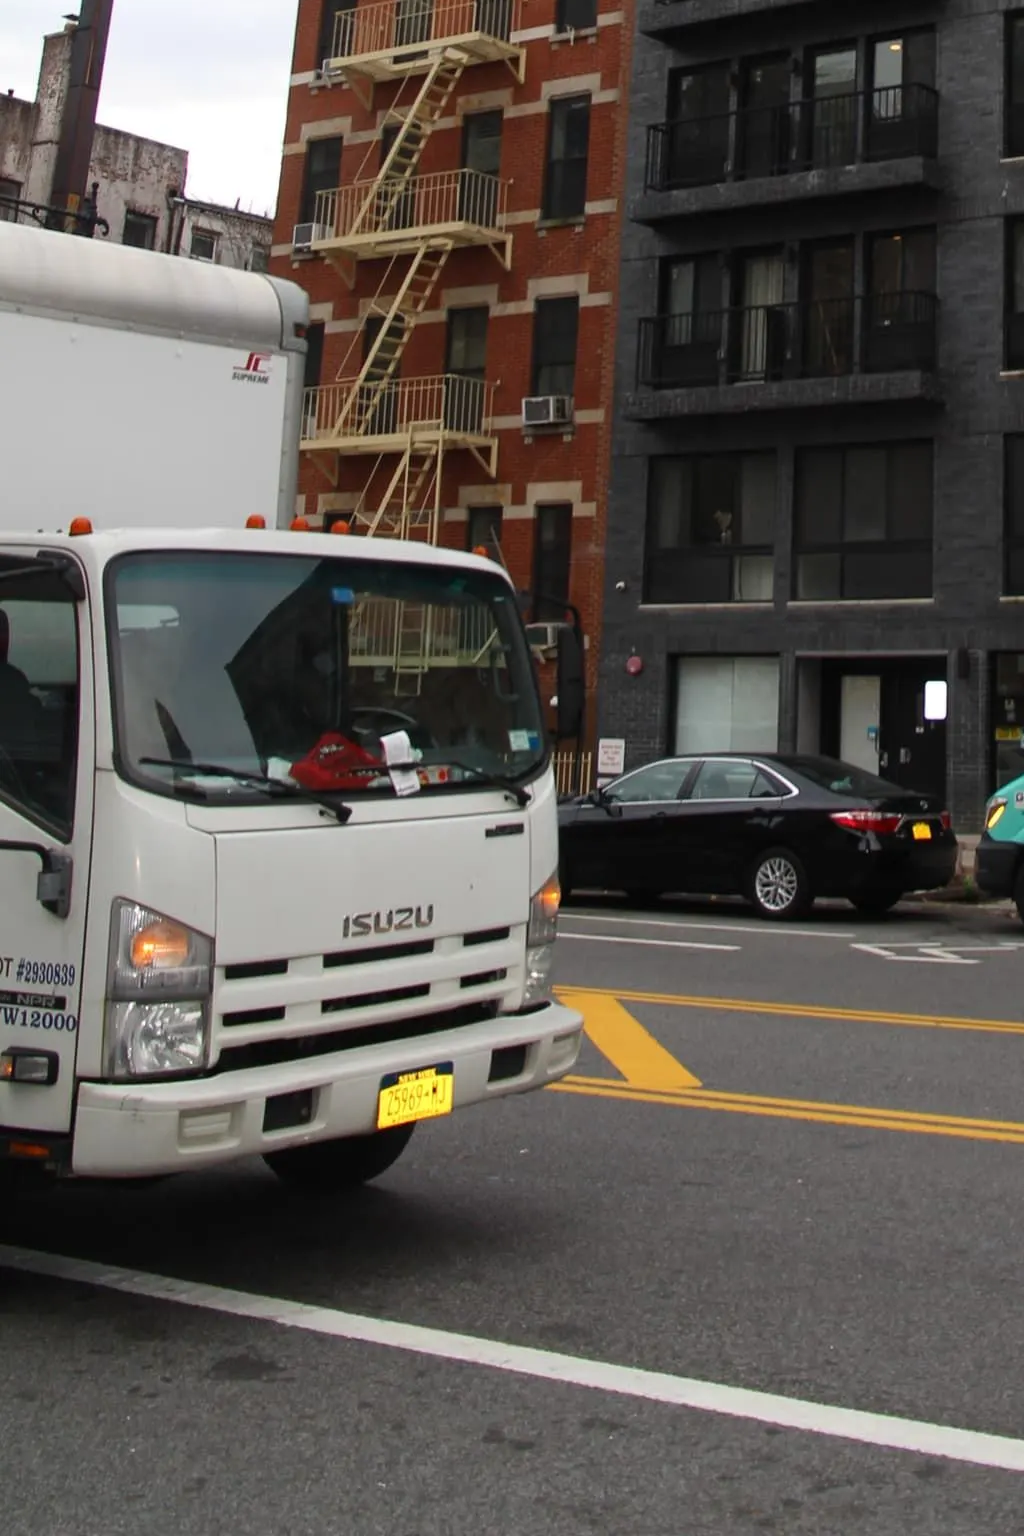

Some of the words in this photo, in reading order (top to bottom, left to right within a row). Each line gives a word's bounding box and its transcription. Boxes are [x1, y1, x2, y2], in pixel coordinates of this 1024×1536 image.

[342, 903, 434, 939] ISUZU
[16, 957, 75, 986] #2930839
[17, 994, 56, 1008] NPR
[0, 1007, 77, 1033] W12000
